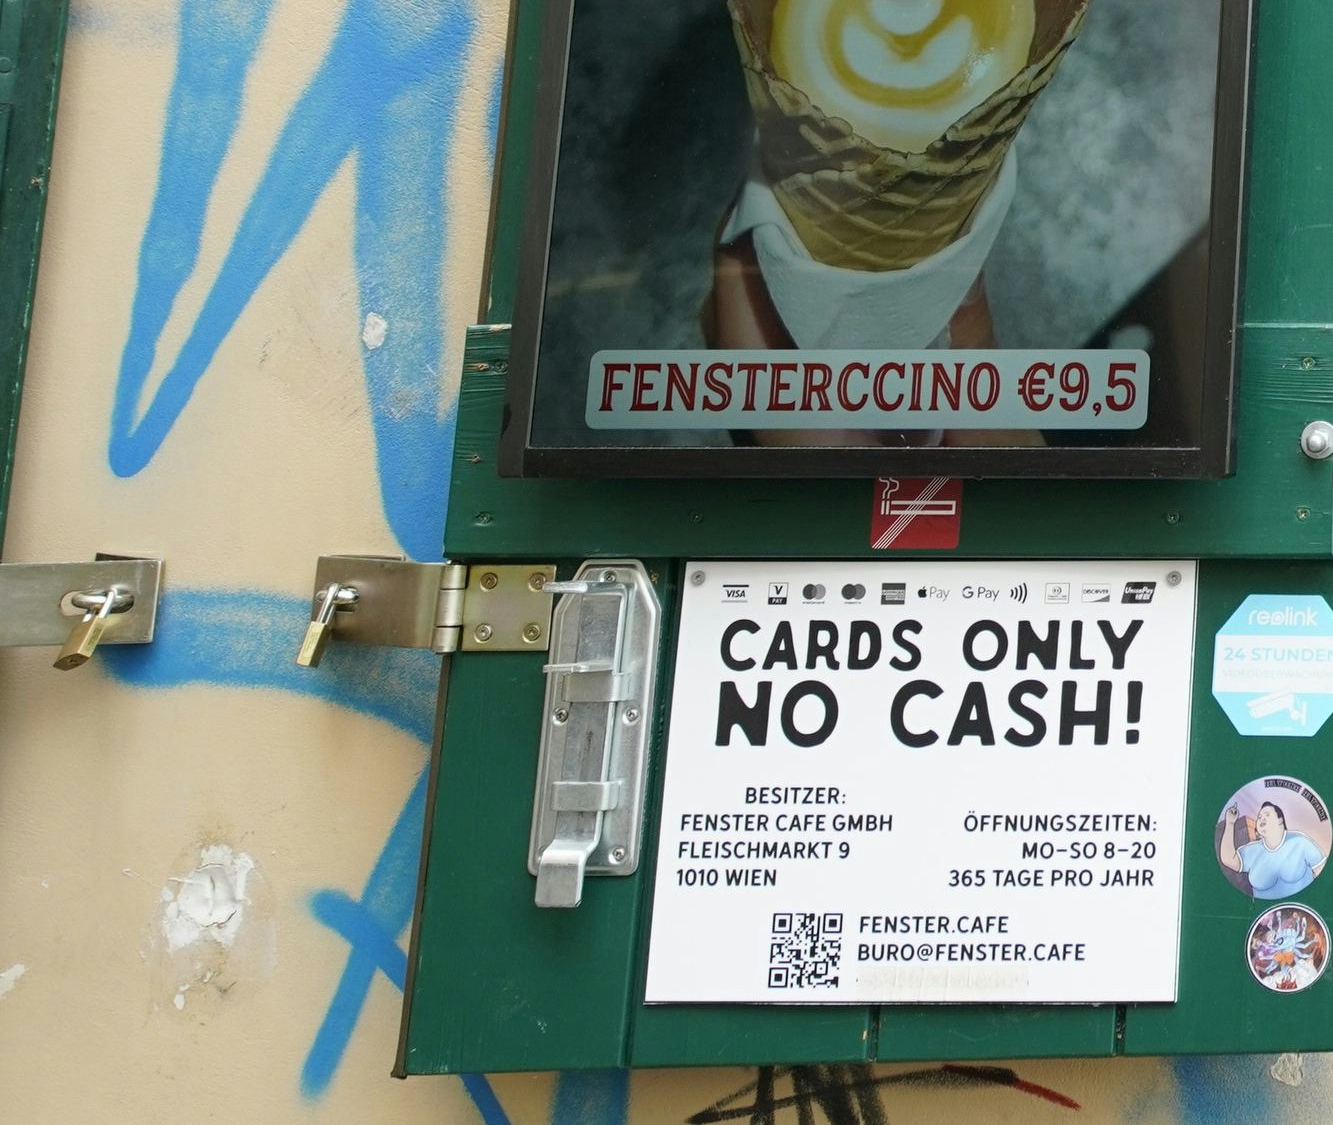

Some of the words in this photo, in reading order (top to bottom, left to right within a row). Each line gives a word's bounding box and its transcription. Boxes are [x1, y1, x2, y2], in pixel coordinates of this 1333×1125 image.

[599, 362, 1001, 413] FENSTERCCINO
[1017, 362, 1138, 418] €9,5
[726, 589, 746, 598] VISA
[929, 587, 950, 600] Pay
[977, 586, 1000, 601] Pay
[720, 618, 923, 672] CARDS
[962, 618, 1144, 671] ONLY
[1223, 647, 1247, 661] 24
[714, 679, 840, 748] NO
[889, 679, 1144, 748] CASH!
[744, 786, 847, 805] BESITZER:
[681, 813, 771, 832] FENSTER
[775, 813, 827, 832] CAFE
[832, 813, 893, 832] GMBH
[963, 810, 1158, 832] ÖFFNUNGSZEITEN:
[678, 841, 834, 859] FLEISCHMARKT
[838, 842, 851, 859] 9
[676, 869, 719, 887] 1010
[725, 869, 777, 887] WIEN
[948, 869, 986, 887] 365
[991, 869, 1044, 887] TAGE
[1050, 869, 1094, 887] PRO
[1099, 869, 1155, 888] JAHR
[859, 915, 1009, 934] FENSTER.CAFE
[857, 943, 1086, 963] BURO@FENSTER.CAFE
